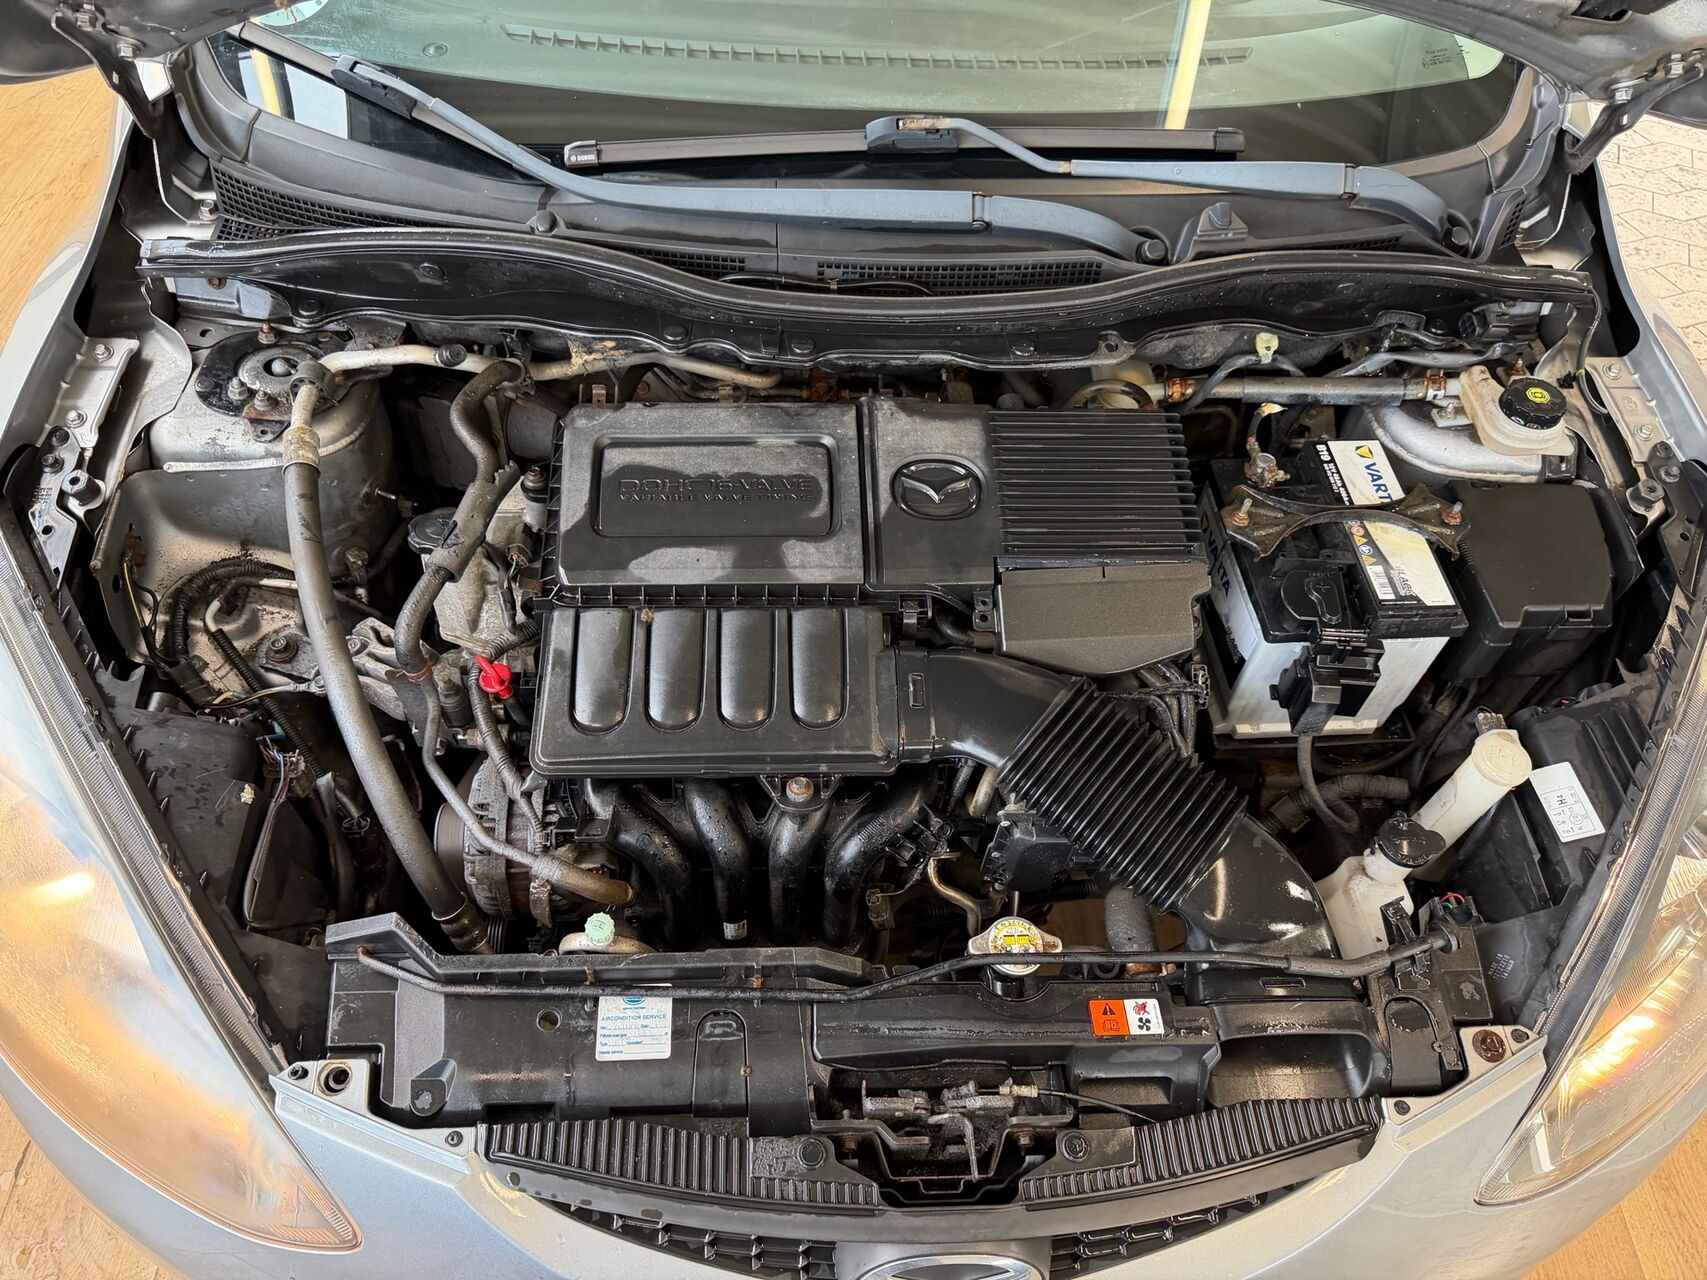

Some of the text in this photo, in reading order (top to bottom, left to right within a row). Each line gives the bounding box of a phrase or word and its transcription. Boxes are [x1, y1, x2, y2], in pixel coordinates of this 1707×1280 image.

[1316, 444, 1331, 461] B19
[618, 478, 812, 492] DOHC 16-VALVE
[618, 493, 812, 503] VARIABLE VALVE TIMING
